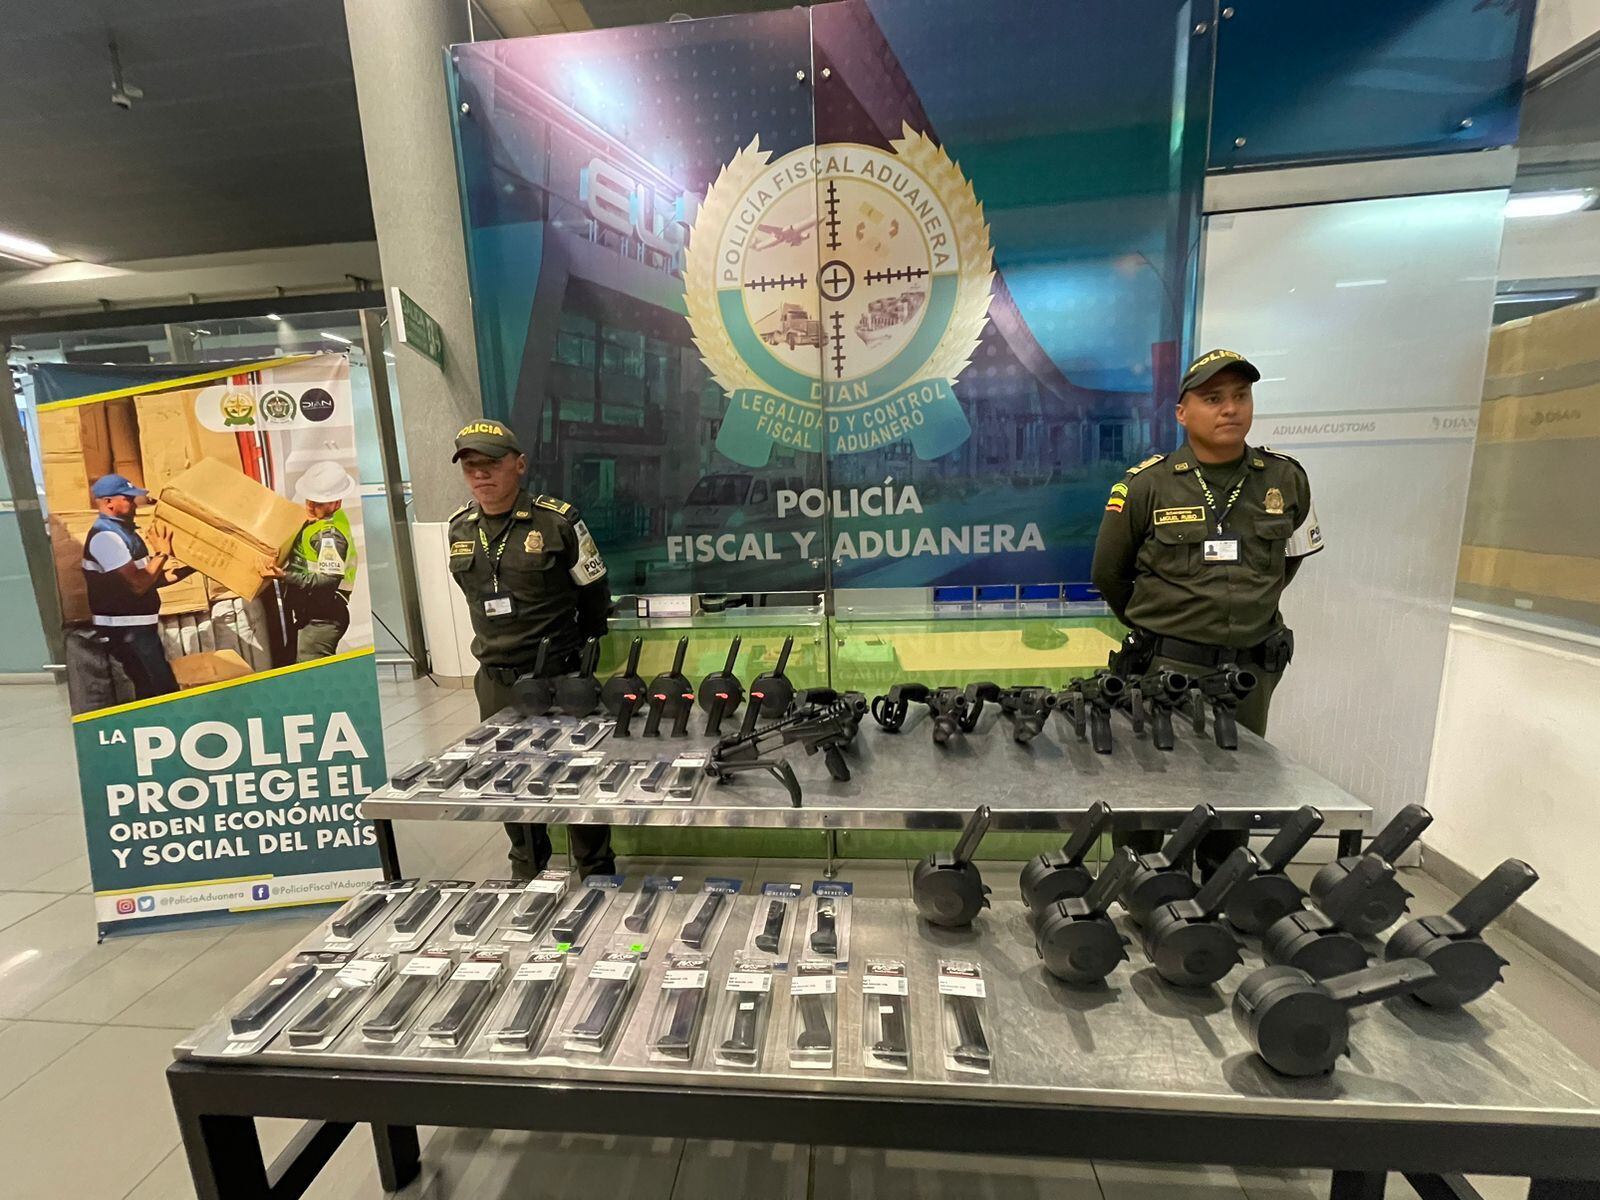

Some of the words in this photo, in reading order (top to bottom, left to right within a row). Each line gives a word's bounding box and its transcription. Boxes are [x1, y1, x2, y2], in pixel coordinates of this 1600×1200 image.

[722, 193, 771, 283] POLICÍA
[773, 154, 855, 191] FISCAL
[860, 157, 952, 269] ADUANERA
[740, 391, 840, 433] LEGALIDAD
[846, 414, 858, 430] Y
[862, 384, 947, 430] CONTROL
[809, 380, 870, 402] DIAN
[456, 423, 504, 440] POLICIA
[755, 414, 813, 449] FISCAL
[835, 411, 925, 453] ADUANERO
[1272, 420, 1376, 436] ADUANA/CUSTOMS
[775, 475, 924, 519] POLICÍA
[666, 533, 781, 564] FISCAL
[786, 530, 817, 562] Y
[830, 521, 1046, 561] ADUANERA
[98, 729, 127, 745] LA
[133, 711, 369, 776] POLFA
[106, 766, 319, 817] PROTEGE
[329, 765, 373, 797] EL
[109, 815, 204, 842] ORDEN
[112, 848, 131, 869] Y
[142, 836, 249, 867] SOCIAL
[259, 831, 308, 855] DEL
[317, 821, 377, 849] PAÍS
[160, 890, 245, 907] @PoliciaAduanera
